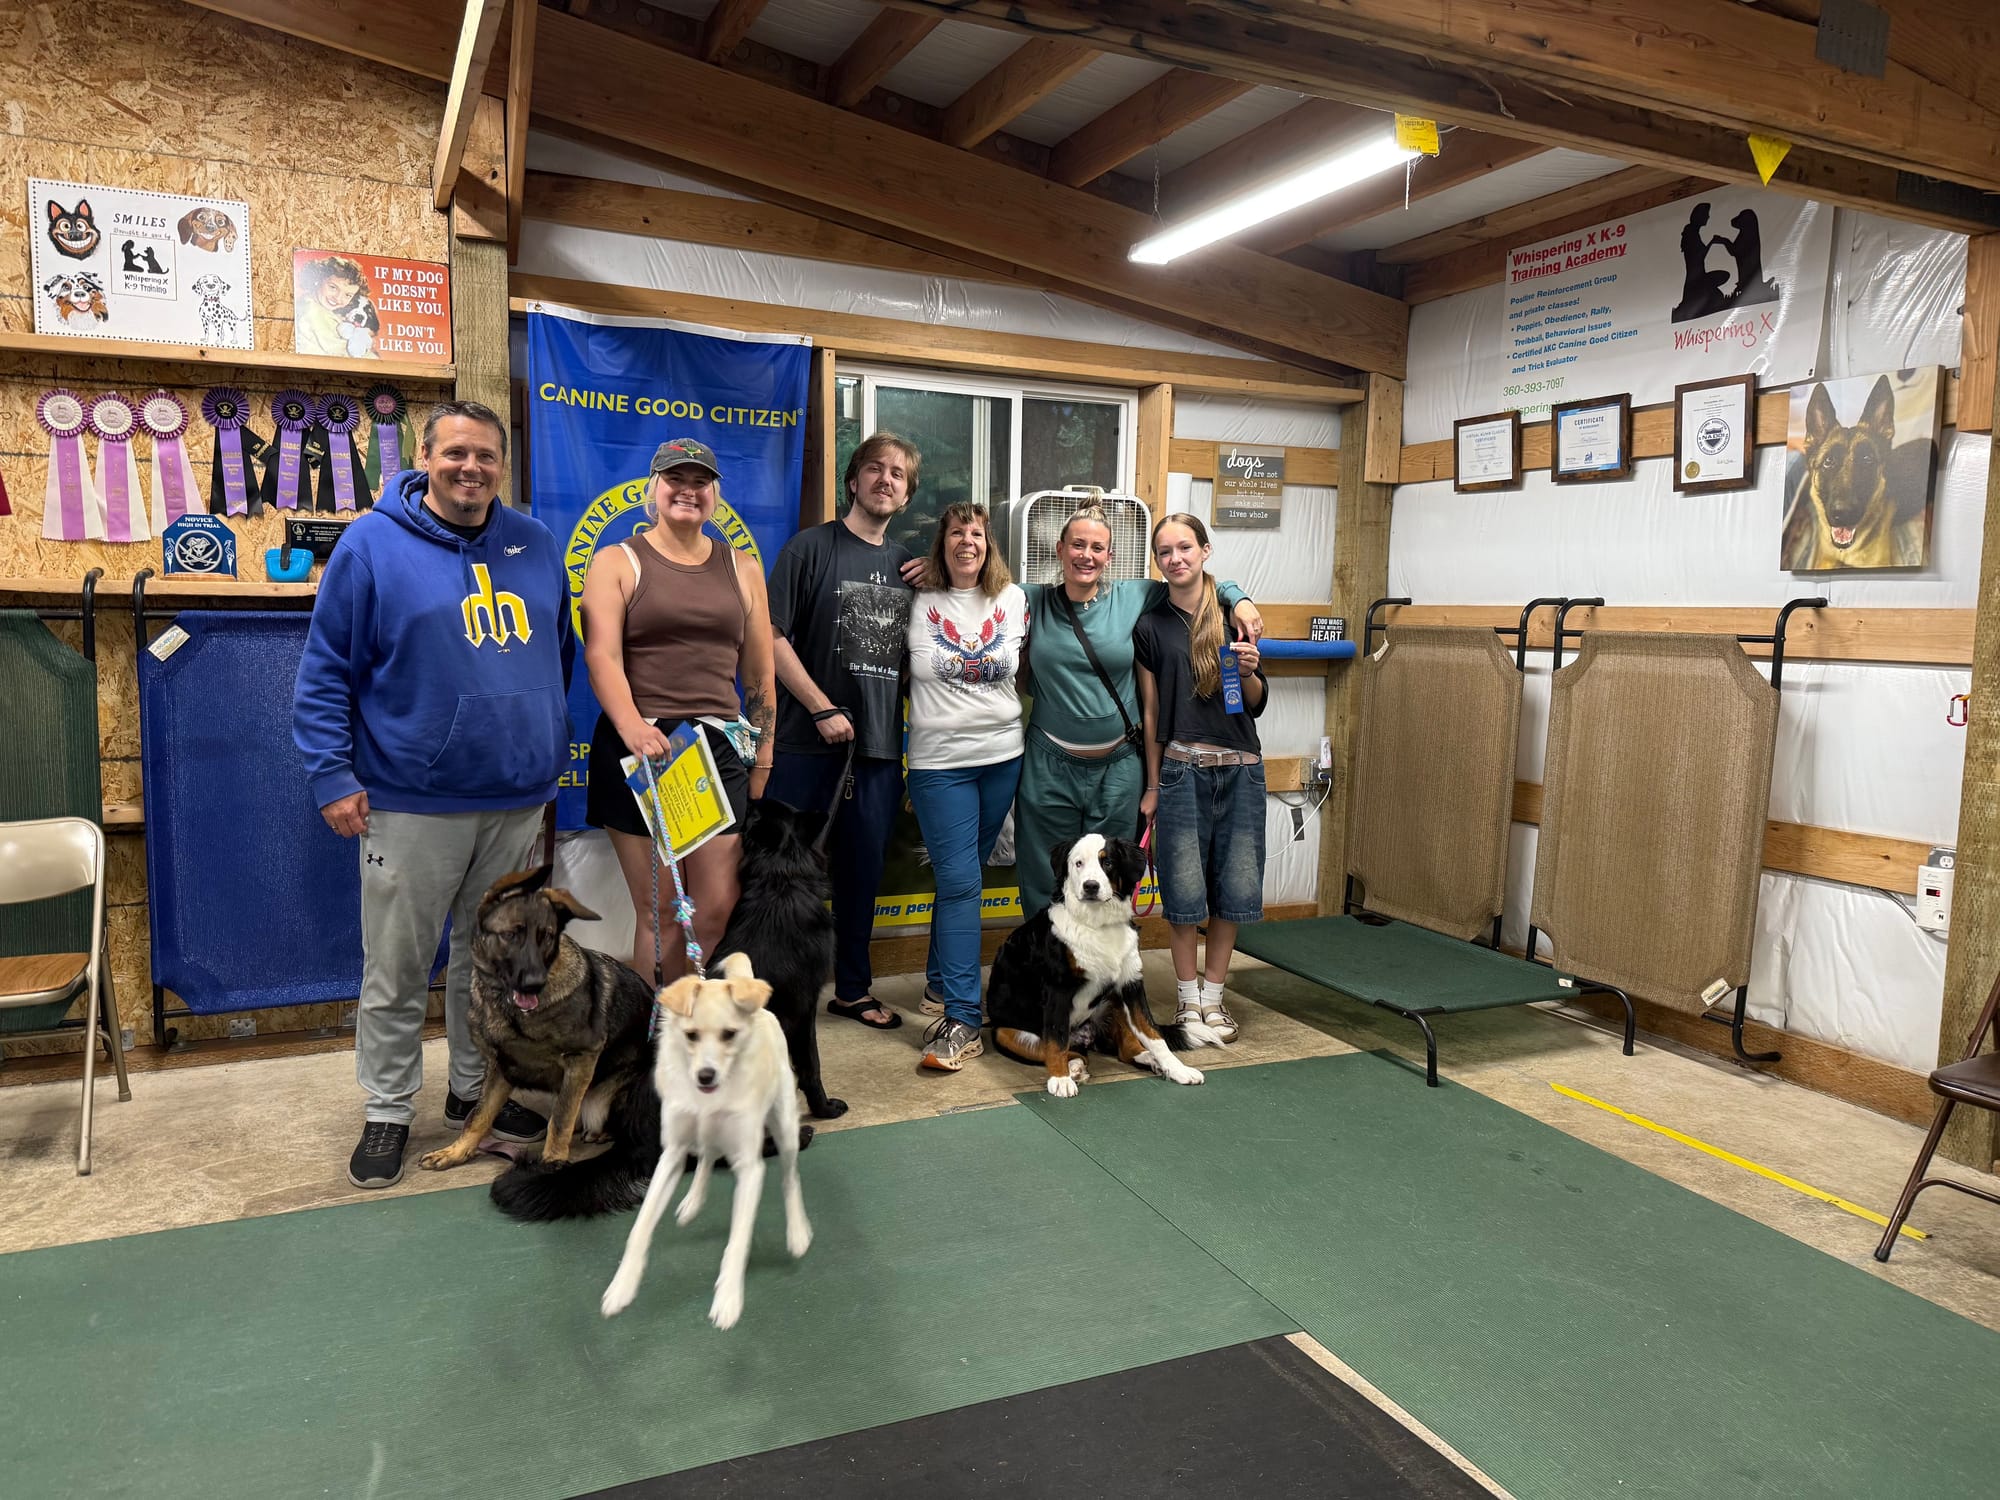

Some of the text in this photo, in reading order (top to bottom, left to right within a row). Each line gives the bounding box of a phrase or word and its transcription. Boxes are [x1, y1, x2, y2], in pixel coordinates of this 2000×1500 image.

[113, 213, 167, 228] SMILES
[1512, 224, 1626, 266] Whispering X K-9
[1511, 243, 1628, 283] Training Academy
[124, 274, 162, 284] Whispering
[374, 266, 444, 284] IF MY DOG
[124, 282, 168, 294] K-9 Training
[383, 283, 438, 300] DOESN'T
[1536, 280, 1593, 298] Reinforcement
[1594, 274, 1618, 285] Group
[378, 299, 445, 317] LIKE YOU,
[1508, 310, 1523, 320] and
[1548, 298, 1580, 310] classes!
[1544, 310, 1588, 325] Obedience,
[1590, 306, 1612, 316] Rally,
[387, 324, 436, 338] I DON'T
[1545, 326, 1586, 340] Behavioral
[1588, 320, 1612, 332] Issues
[1674, 312, 1775, 352] Whispering X
[380, 338, 447, 355] LIKE YOU.
[1512, 328, 1638, 360] Certified AKC Canine Good Citizen
[1512, 355, 1578, 374] and Trick Evaluator
[1502, 376, 1565, 397] 360-393-7097
[539, 382, 629, 413] CANINE
[635, 397, 704, 420] GOOD
[1574, 416, 1604, 426] CERTIFICATE
[1226, 448, 1264, 479] dogs
[1238, 480, 1258, 488] whole
[1250, 490, 1264, 500] they
[1229, 510, 1268, 519] lives whole
[568, 496, 618, 598] CANINE
[1312, 630, 1342, 641] HEART
[849, 662, 860, 672] The
